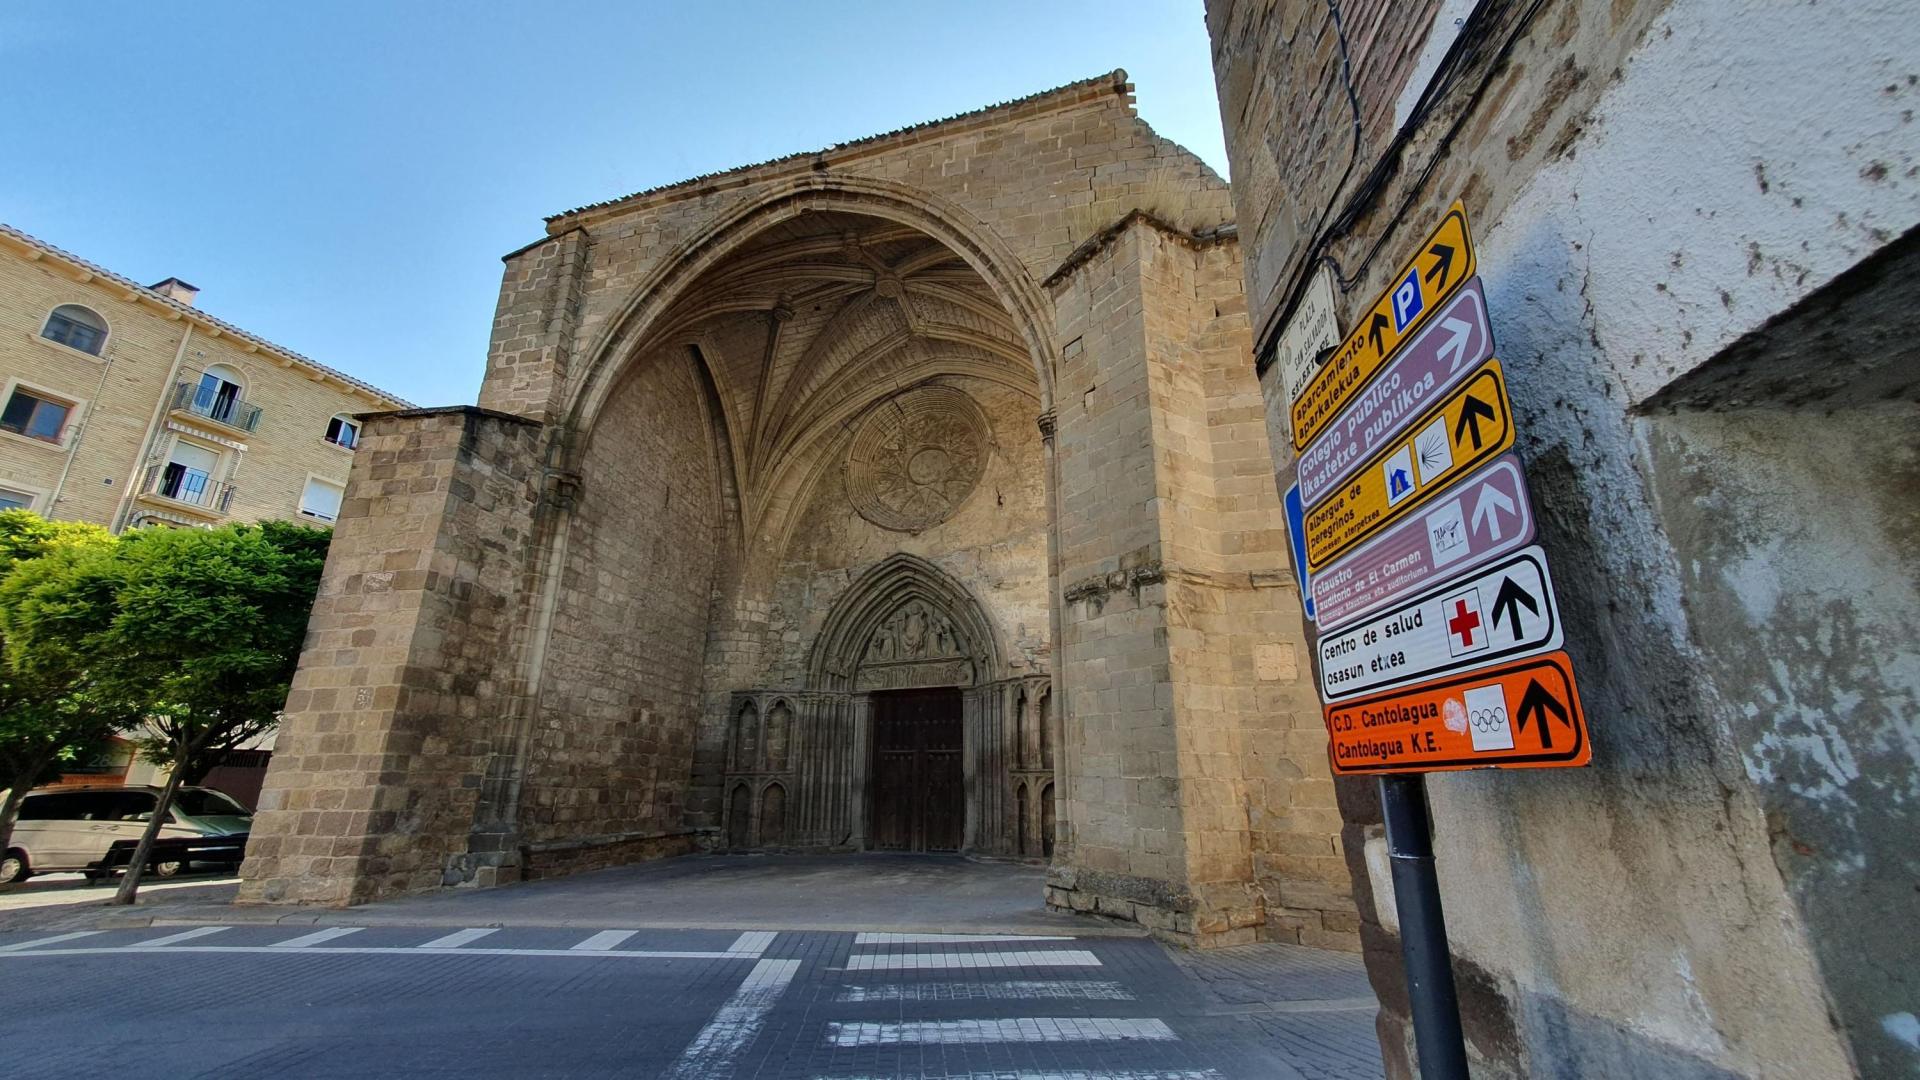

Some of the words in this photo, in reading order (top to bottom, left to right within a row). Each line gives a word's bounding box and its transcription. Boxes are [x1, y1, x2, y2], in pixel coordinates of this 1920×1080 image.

[1299, 302, 1315, 335] PLAZA
[1397, 281, 1414, 325] P
[1294, 348, 1304, 371] SAN
[1304, 308, 1328, 355] SALVADOR
[1297, 335, 1365, 421] aparcamiento
[1299, 365, 1360, 439] aparkalekua
[1302, 431, 1341, 476] colegio
[1348, 373, 1400, 438] público
[1303, 442, 1357, 498] ikastetxe
[1364, 371, 1435, 449] publikoa
[1309, 498, 1345, 532] albergue
[1349, 484, 1361, 500] de
[1311, 509, 1355, 549] peregrinos
[1344, 509, 1380, 538] aterpetxea
[1317, 568, 1352, 596] claustro
[1319, 586, 1351, 610] auditorio
[1355, 579, 1365, 592] de
[1369, 570, 1379, 585] El
[1383, 550, 1421, 577] Carmen
[1387, 565, 1428, 590] auditoriuma
[1324, 635, 1357, 661] centro
[1363, 629, 1378, 647] de
[1385, 609, 1424, 639] salud
[1327, 663, 1365, 686] osasun
[1371, 650, 1406, 674] etxea
[1334, 712, 1357, 732] C.D.
[1361, 701, 1438, 728] Cantolagua
[1337, 736, 1404, 761] Cantolagua
[1411, 730, 1442, 754] K.E.
